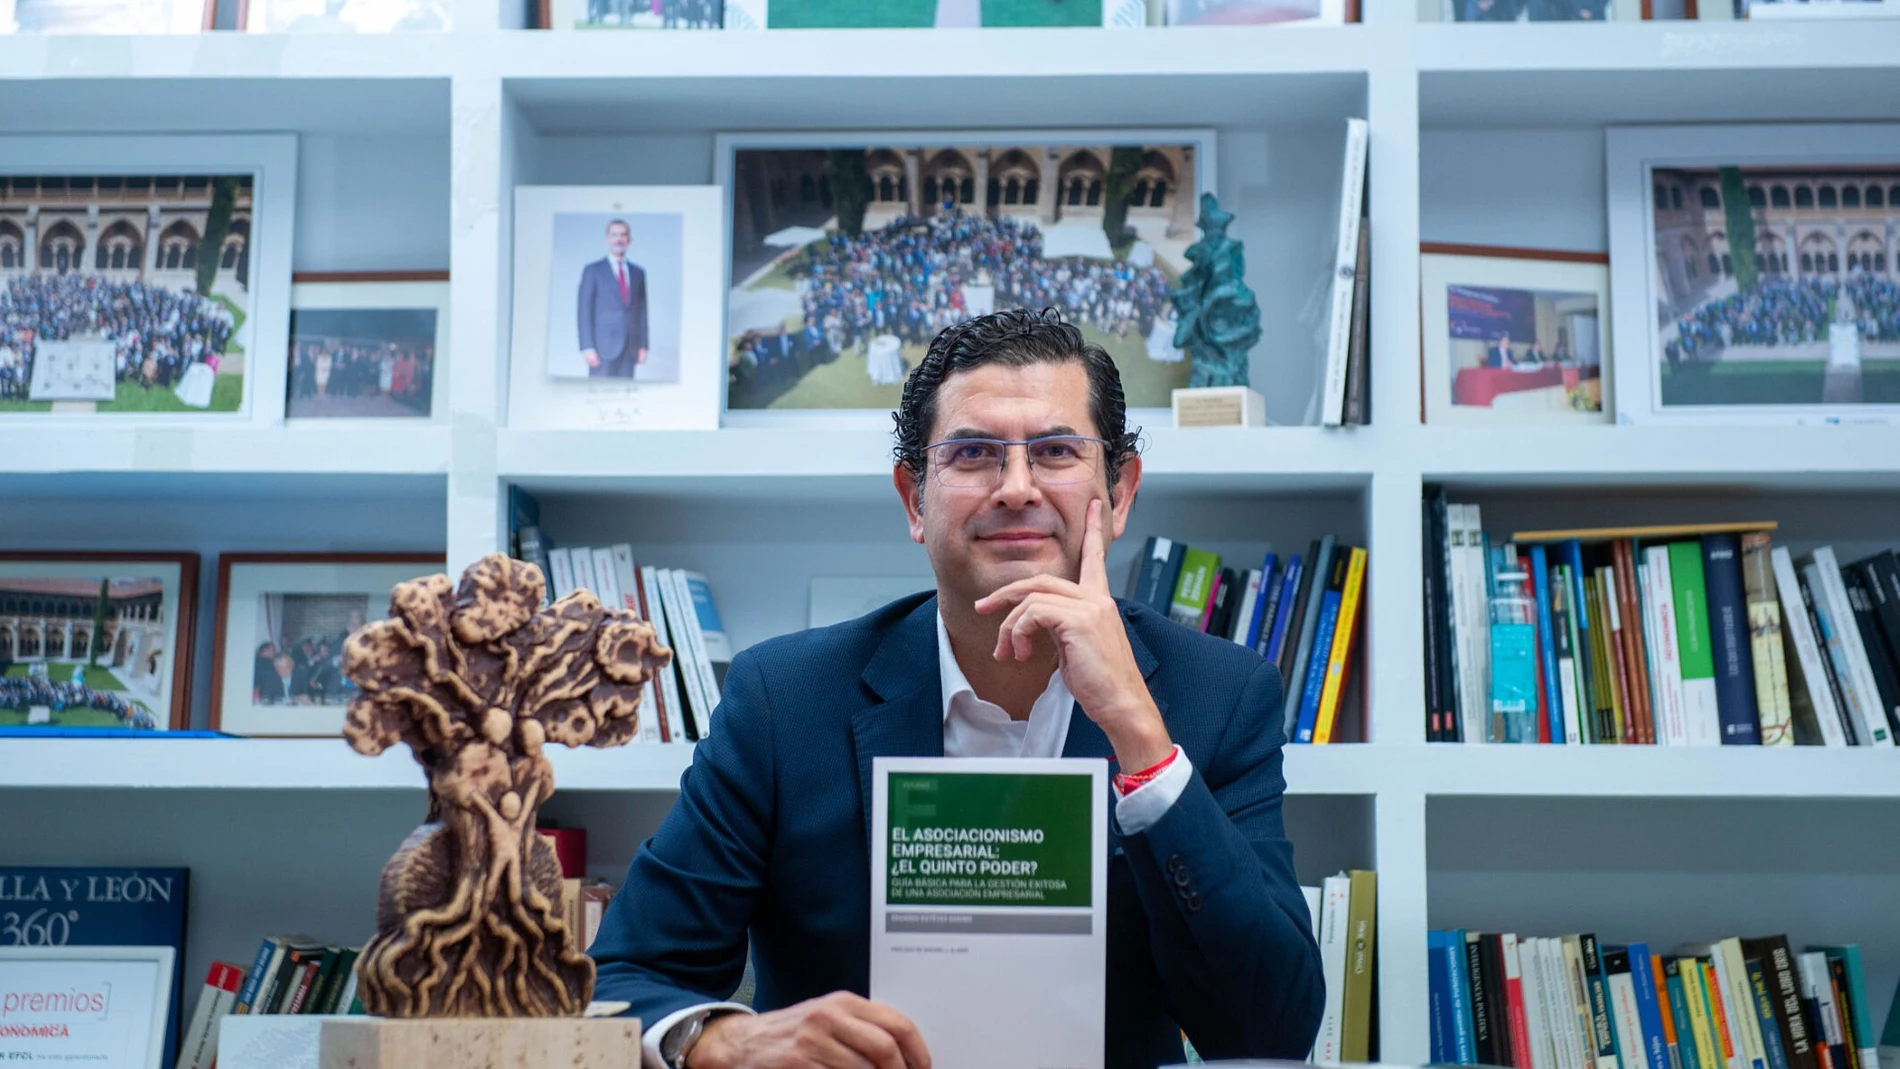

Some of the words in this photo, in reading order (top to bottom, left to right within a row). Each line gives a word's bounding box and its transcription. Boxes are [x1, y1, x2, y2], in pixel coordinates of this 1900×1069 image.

[892, 827, 910, 842] EL
[912, 828, 1044, 844] ASOCIACIONISMO
[892, 844, 1000, 859] EMPRESARIAL:
[891, 859, 917, 876] ¿EL
[919, 860, 977, 875] QUINTO
[980, 860, 1038, 875] PODER?
[60, 879, 80, 901] Y
[87, 872, 174, 903] LEÓN
[891, 877, 913, 887] GUÍA
[915, 877, 948, 887] BÁSICA
[949, 879, 973, 888] PARA
[974, 879, 987, 888] LA
[988, 878, 1027, 889] GESTIÓN
[1028, 879, 1067, 890] EXITOSA
[891, 889, 902, 898] DE
[905, 889, 924, 898] UNA
[926, 888, 982, 899] ASOCIACIÓN
[983, 890, 1045, 900] EMPRESARIAL
[1772, 947, 1789, 971] GRIS
[1777, 970, 1795, 996] LOBO
[1784, 994, 1800, 1015] DEL
[1788, 1013, 1806, 1040] HORA
[1793, 1039, 1809, 1055] LA
